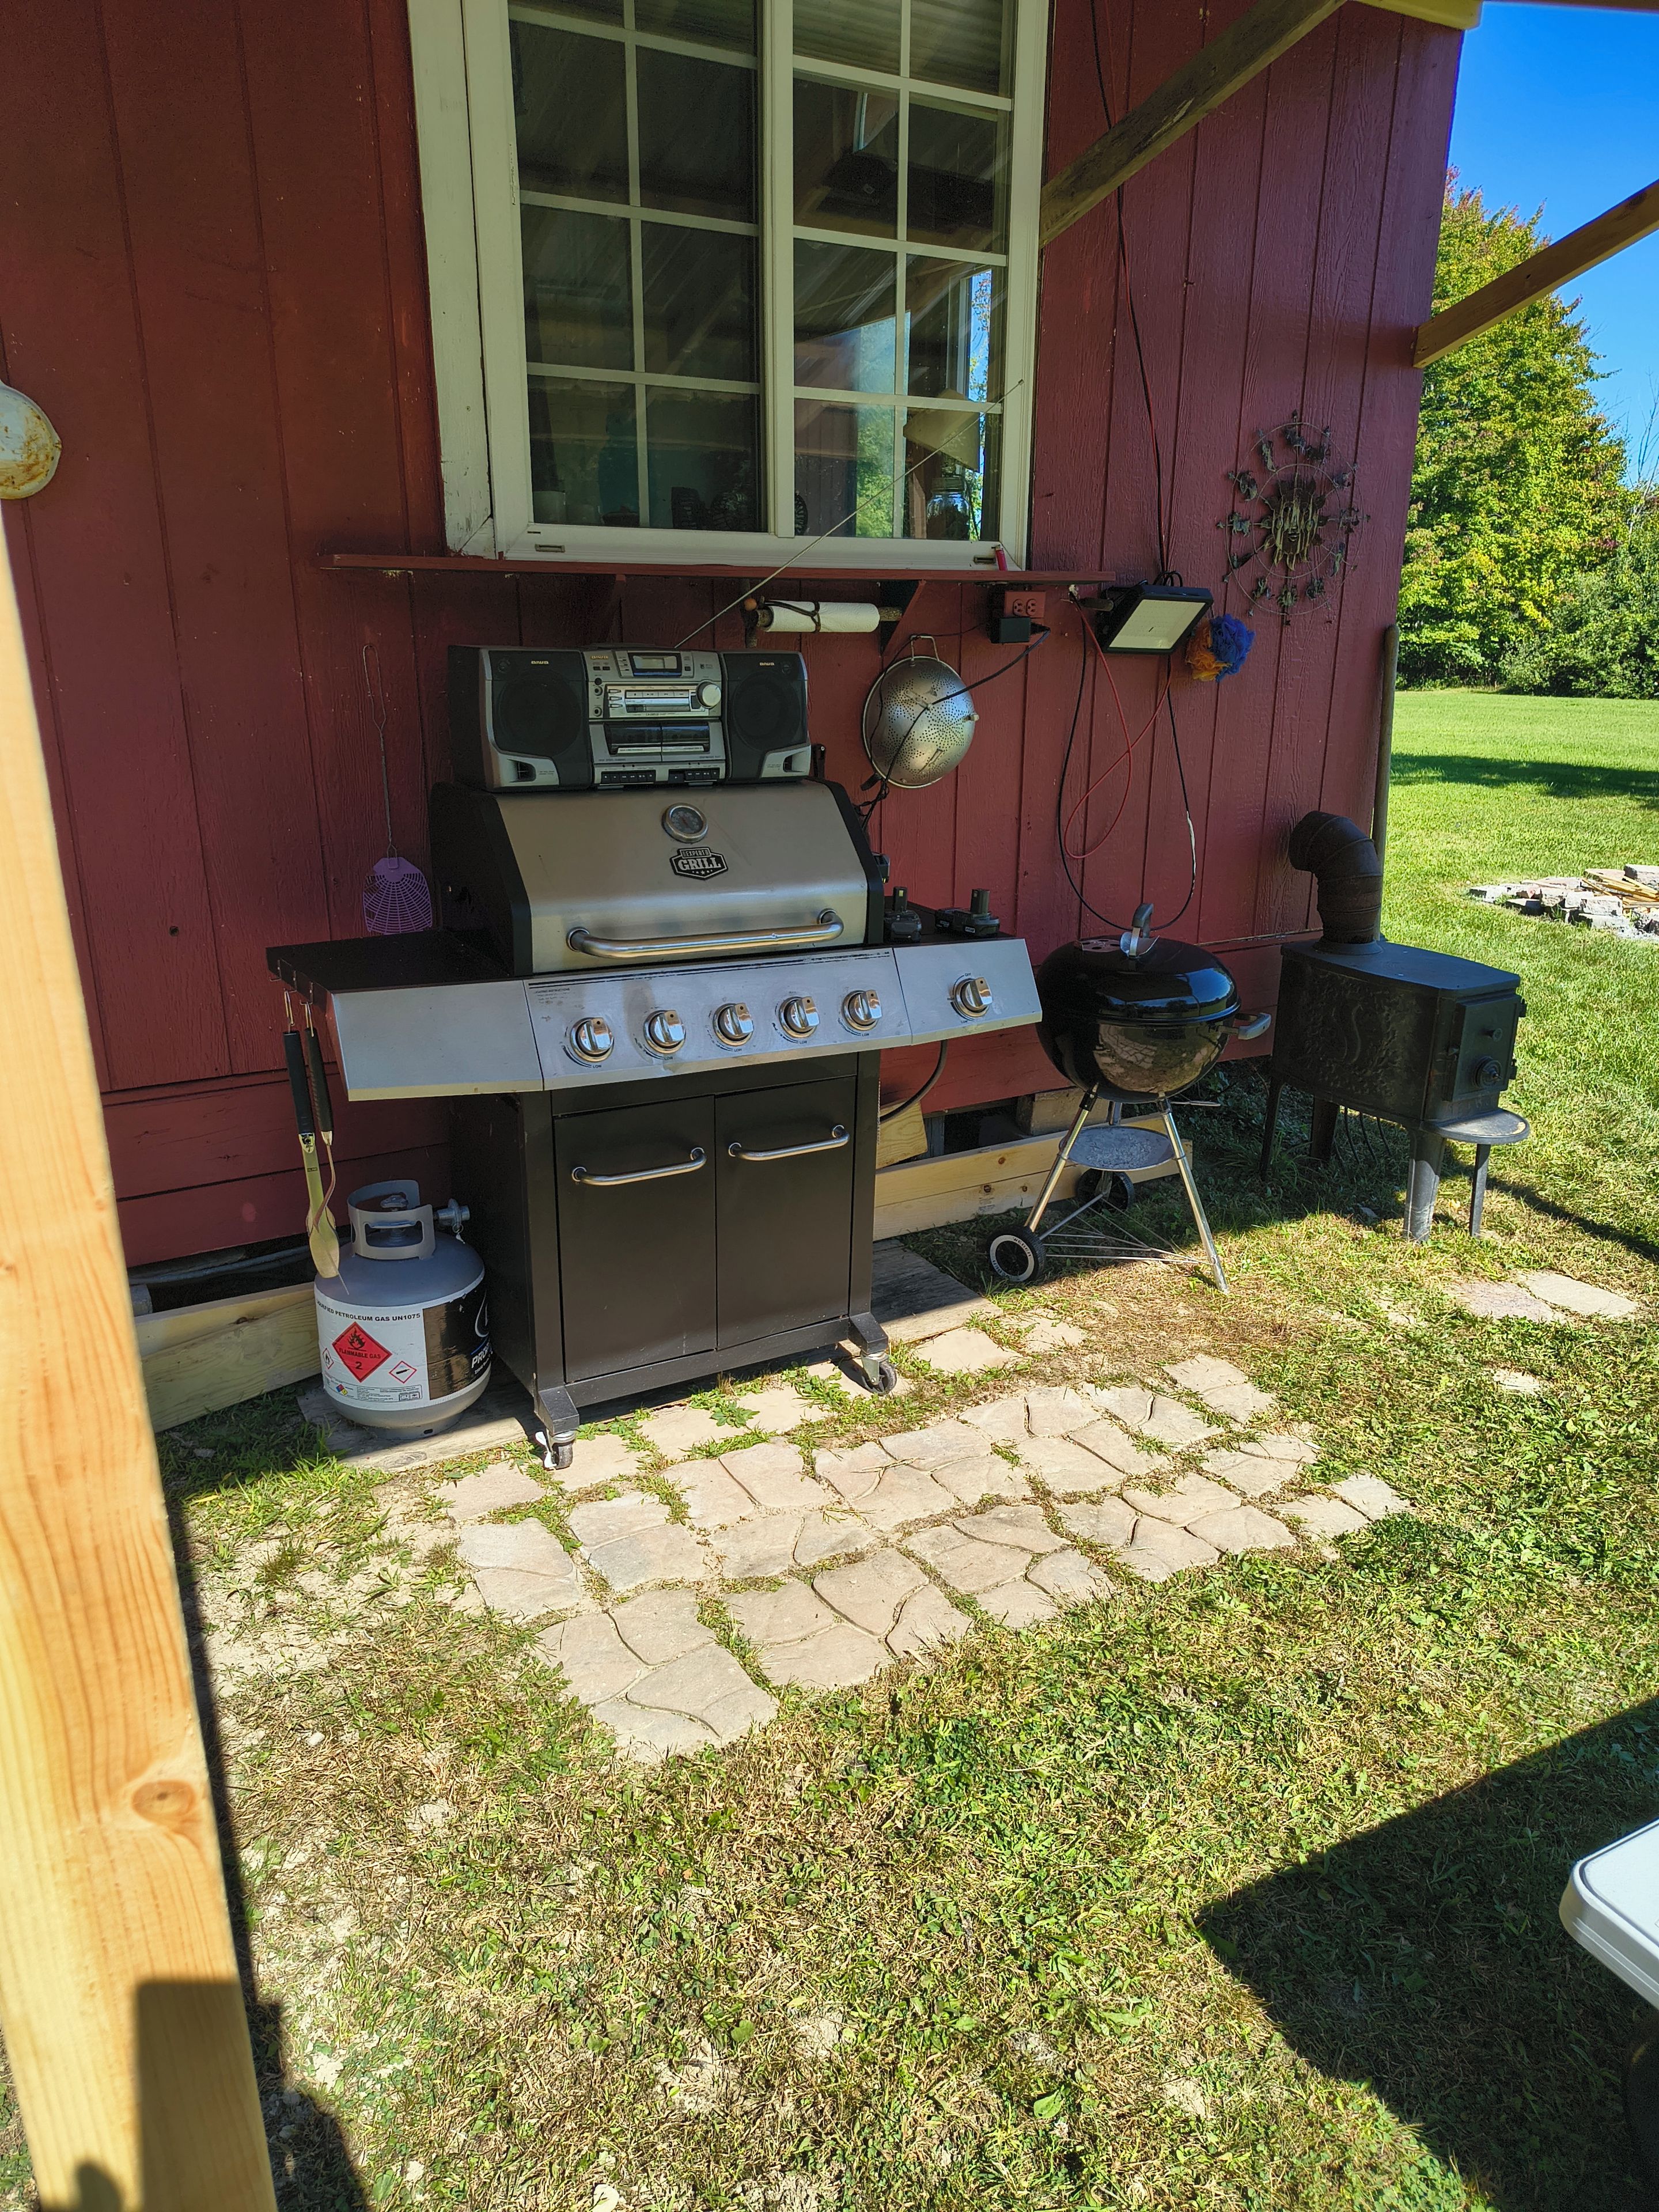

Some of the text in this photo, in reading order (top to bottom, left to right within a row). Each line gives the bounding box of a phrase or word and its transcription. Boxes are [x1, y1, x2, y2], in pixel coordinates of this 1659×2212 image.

[677, 857, 721, 870] GRILL
[335, 1310, 373, 1321] PETROLEUM
[392, 1313, 421, 1321] UN1075
[339, 1347, 368, 1358] FLAMMABLE
[355, 1361, 363, 1370] 2
